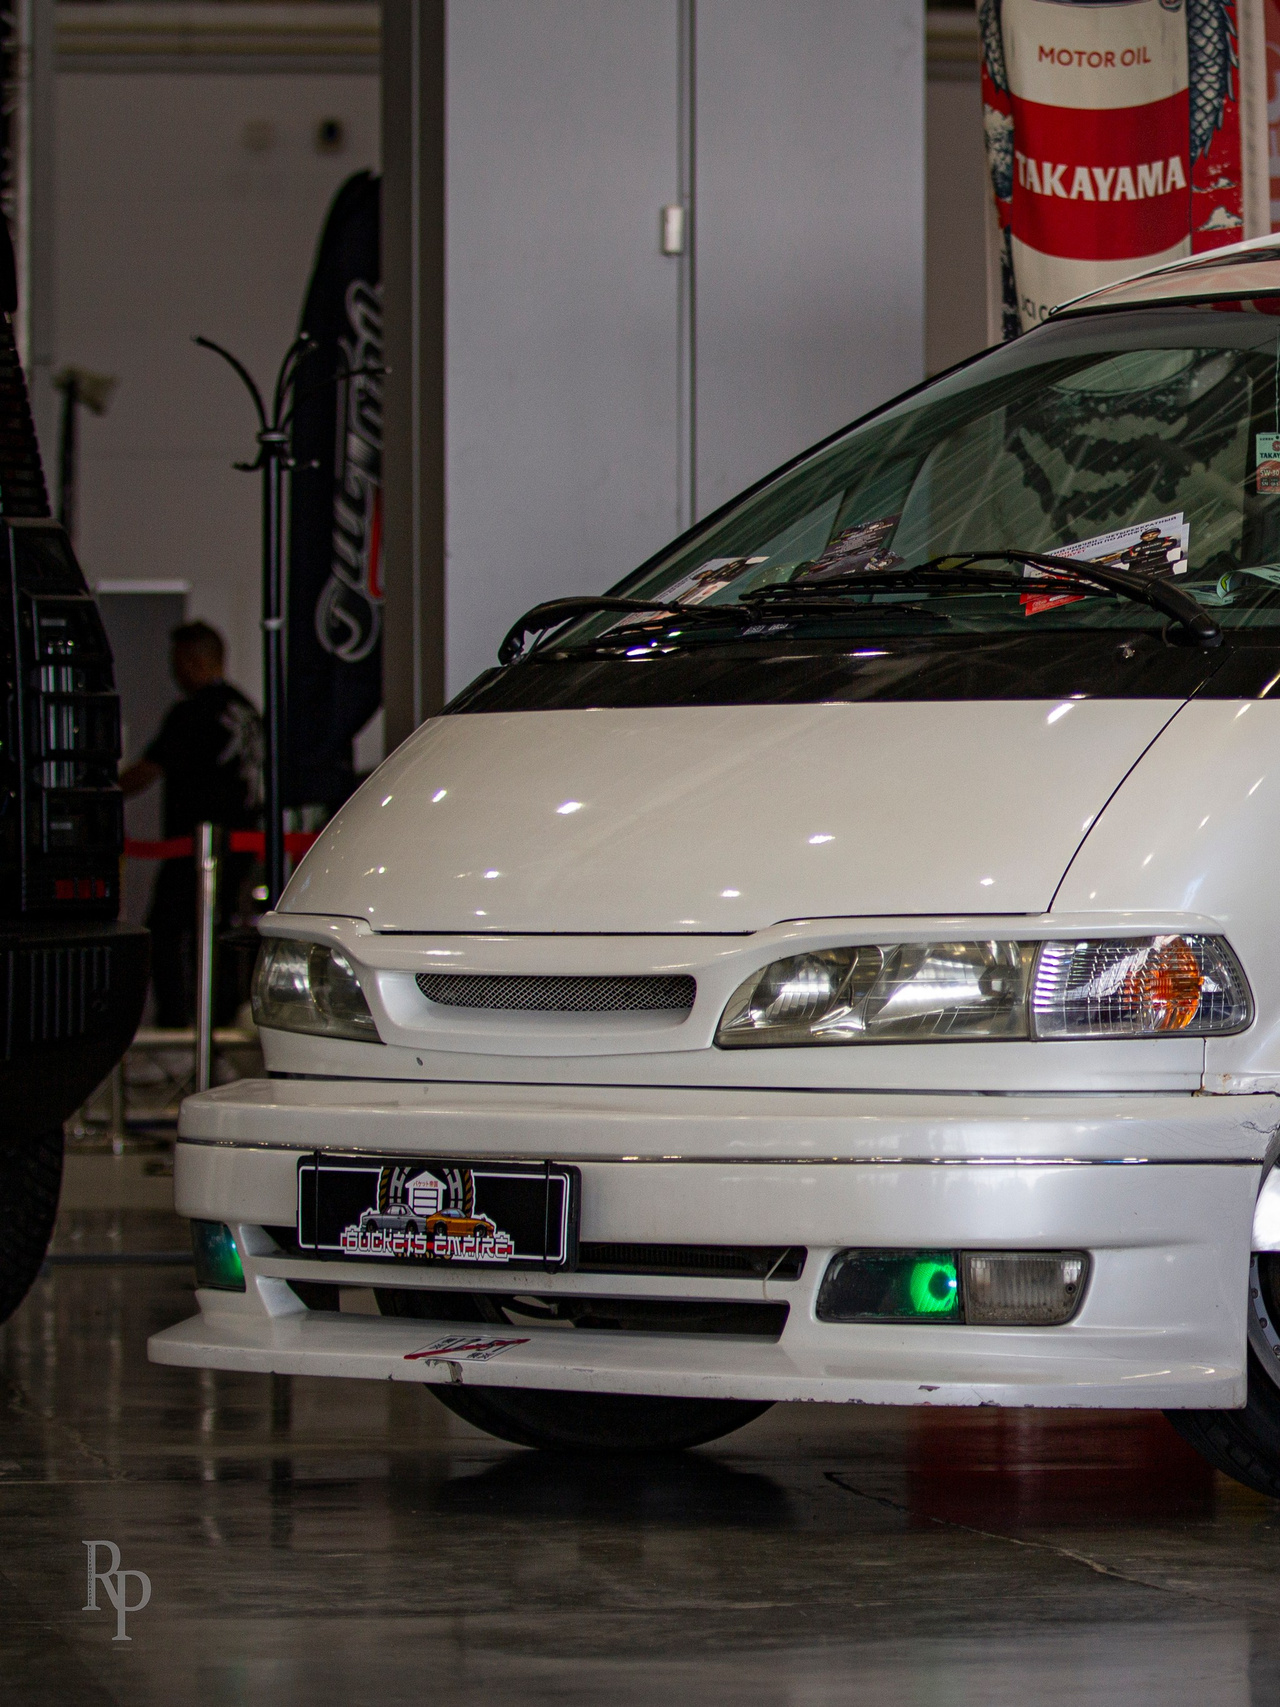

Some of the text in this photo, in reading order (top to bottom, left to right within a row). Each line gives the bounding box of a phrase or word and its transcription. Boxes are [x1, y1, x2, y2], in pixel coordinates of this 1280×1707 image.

[1037, 45, 1152, 68] MOTOR OIL
[1015, 151, 1187, 202] TAKAYAMA
